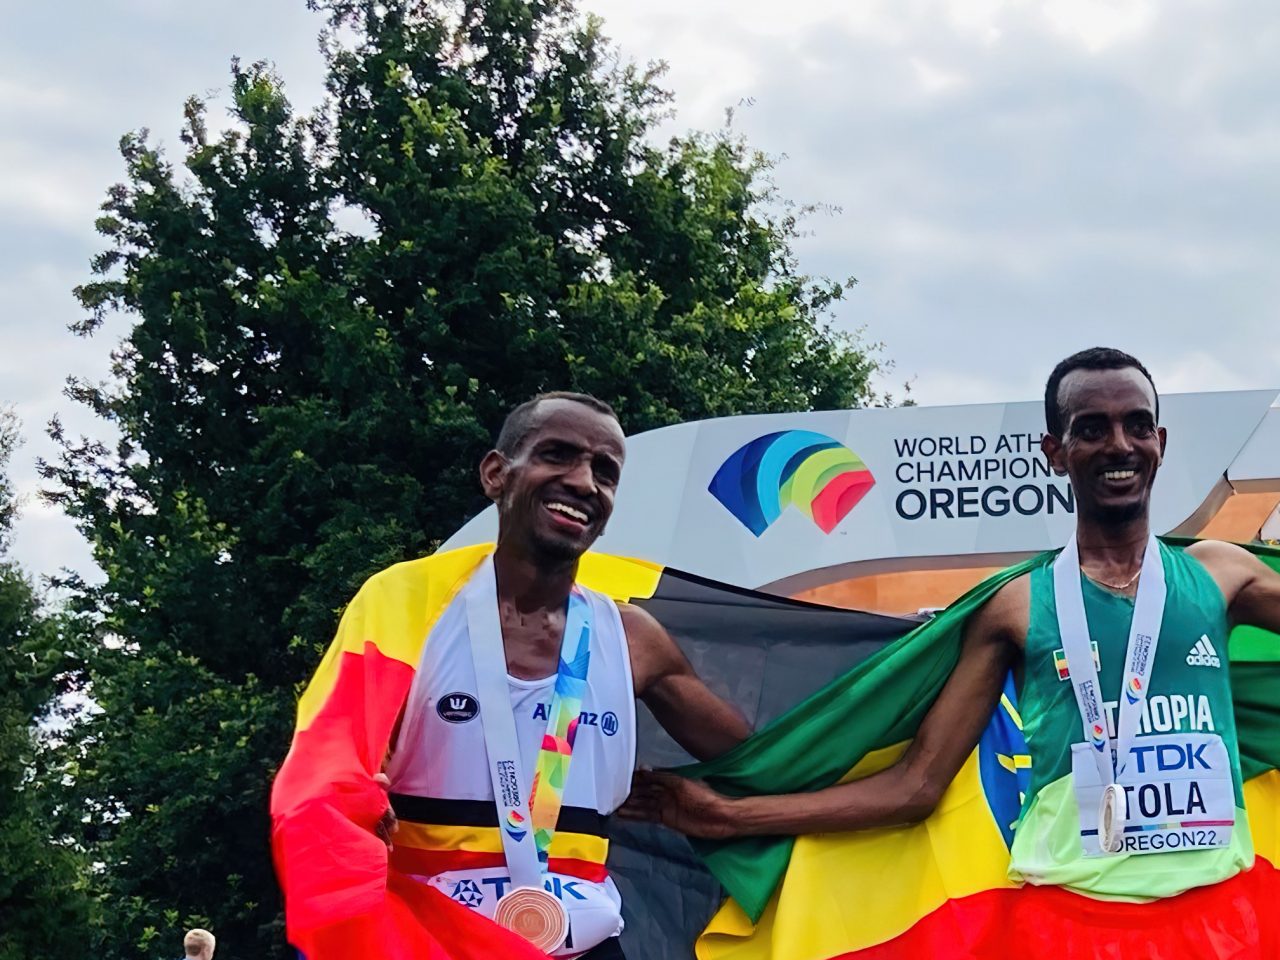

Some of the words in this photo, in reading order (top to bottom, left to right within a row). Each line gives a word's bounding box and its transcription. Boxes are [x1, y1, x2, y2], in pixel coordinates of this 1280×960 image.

[894, 435, 987, 458] WORLD
[994, 432, 1044, 454] ATH
[895, 456, 1052, 484] CHAMPION
[895, 483, 1075, 520] OREGON
[1085, 694, 1215, 740] TIOPIA
[1129, 743, 1212, 773] TDK
[1123, 781, 1207, 820] TOLA
[482, 876, 588, 901] TK
